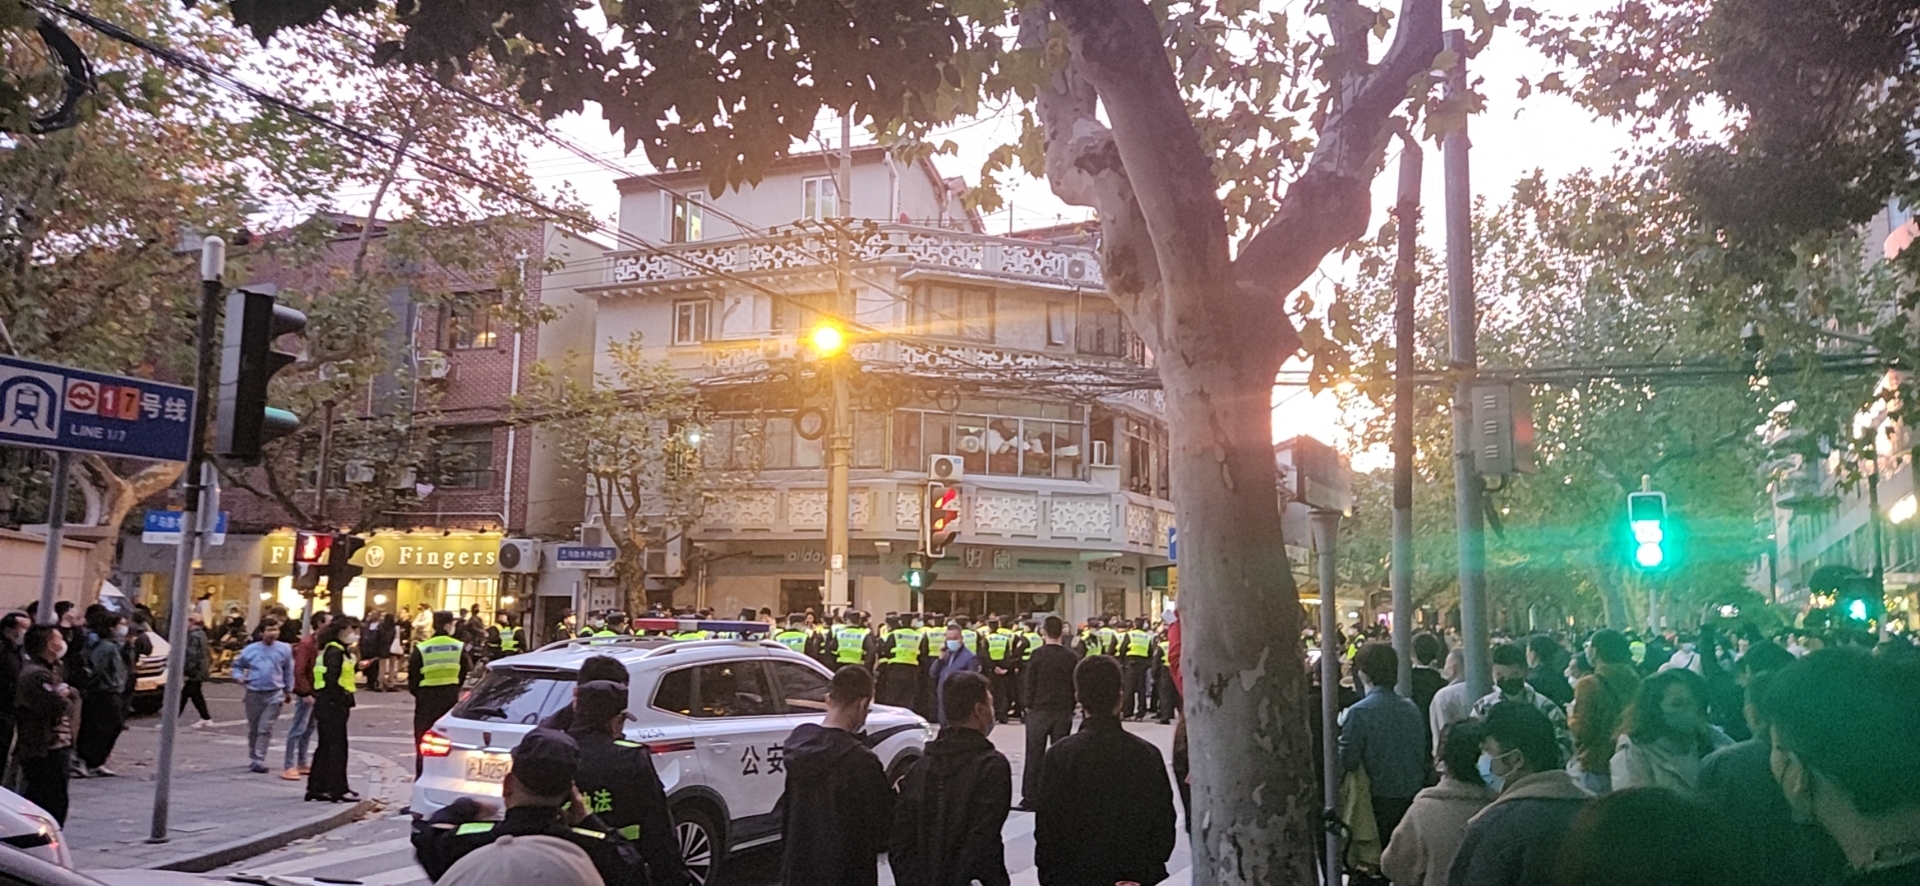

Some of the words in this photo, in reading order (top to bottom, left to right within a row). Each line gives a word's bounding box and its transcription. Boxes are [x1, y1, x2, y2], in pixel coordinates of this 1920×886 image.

[70, 423, 104, 439] LINE
[398, 546, 497, 569] Fingers
[638, 729, 666, 739] 0254
[740, 742, 785, 777] 公安
